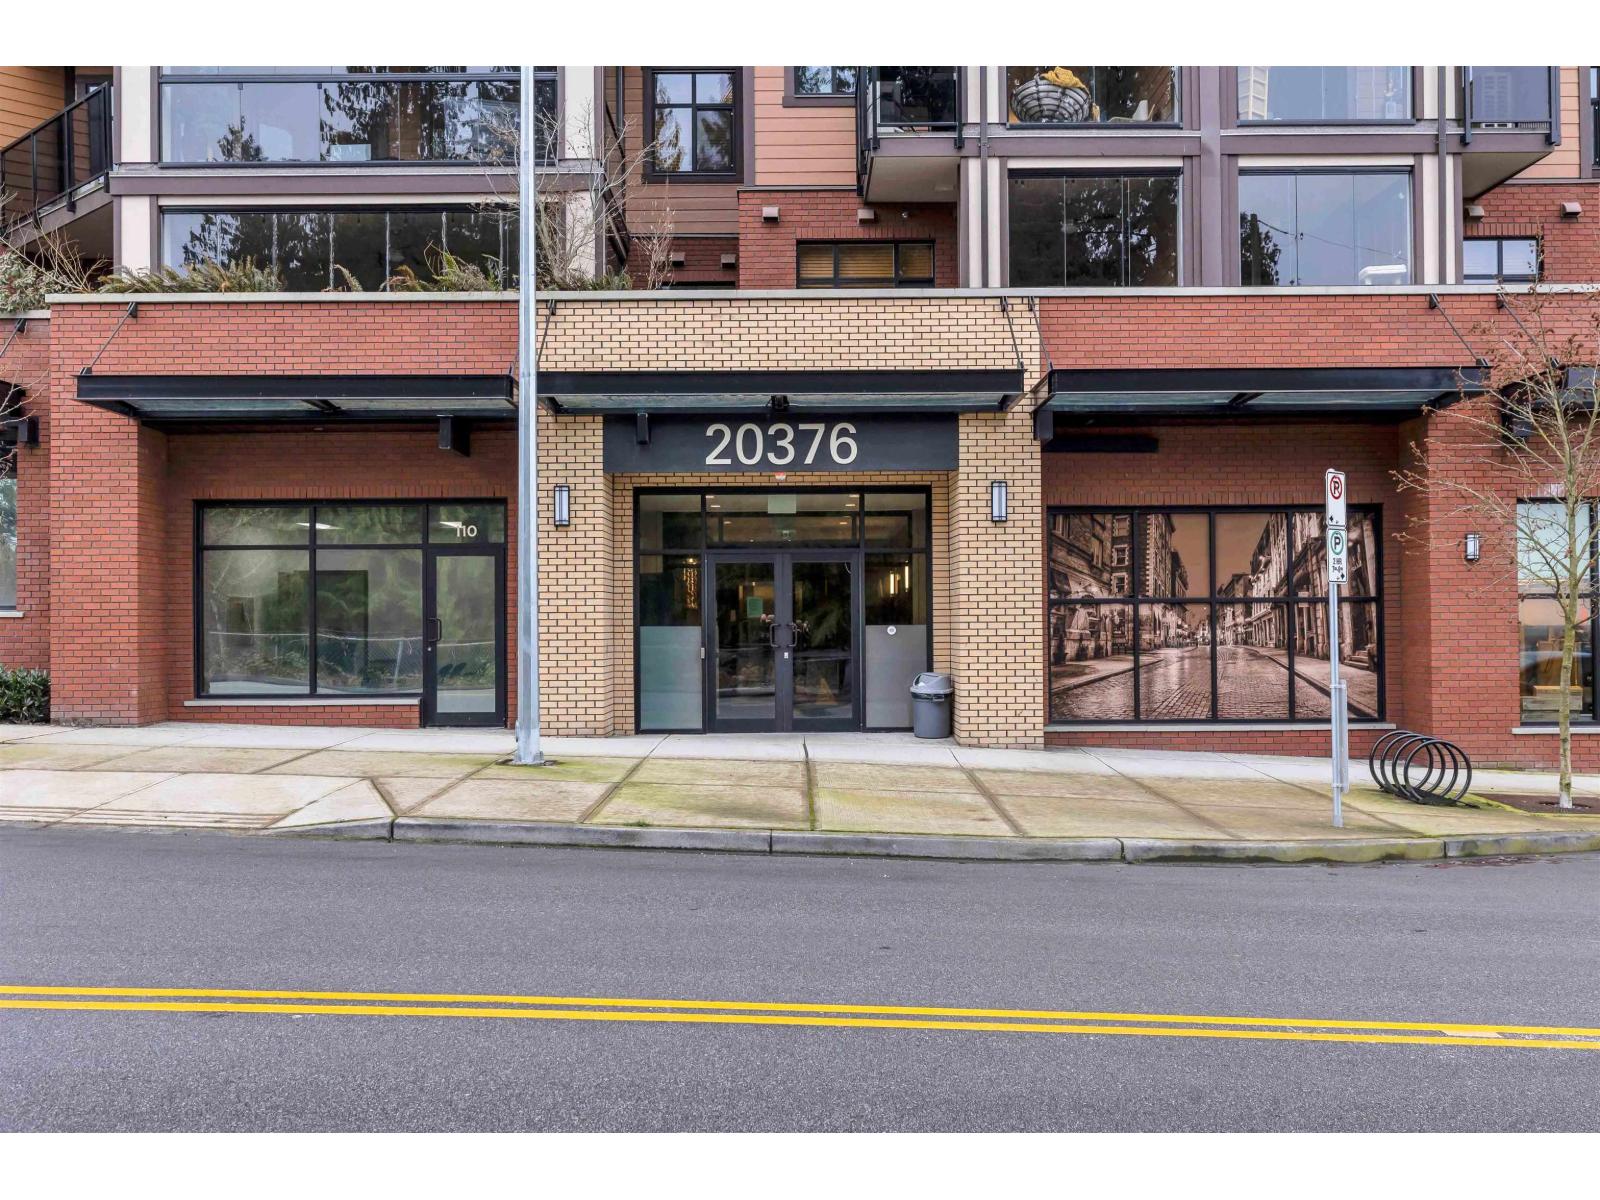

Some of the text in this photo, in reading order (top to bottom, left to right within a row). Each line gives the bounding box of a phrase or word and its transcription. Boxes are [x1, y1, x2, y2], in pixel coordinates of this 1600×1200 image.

[705, 423, 858, 465] 20376
[456, 525, 478, 537] 110
[1334, 536, 1341, 549] P
